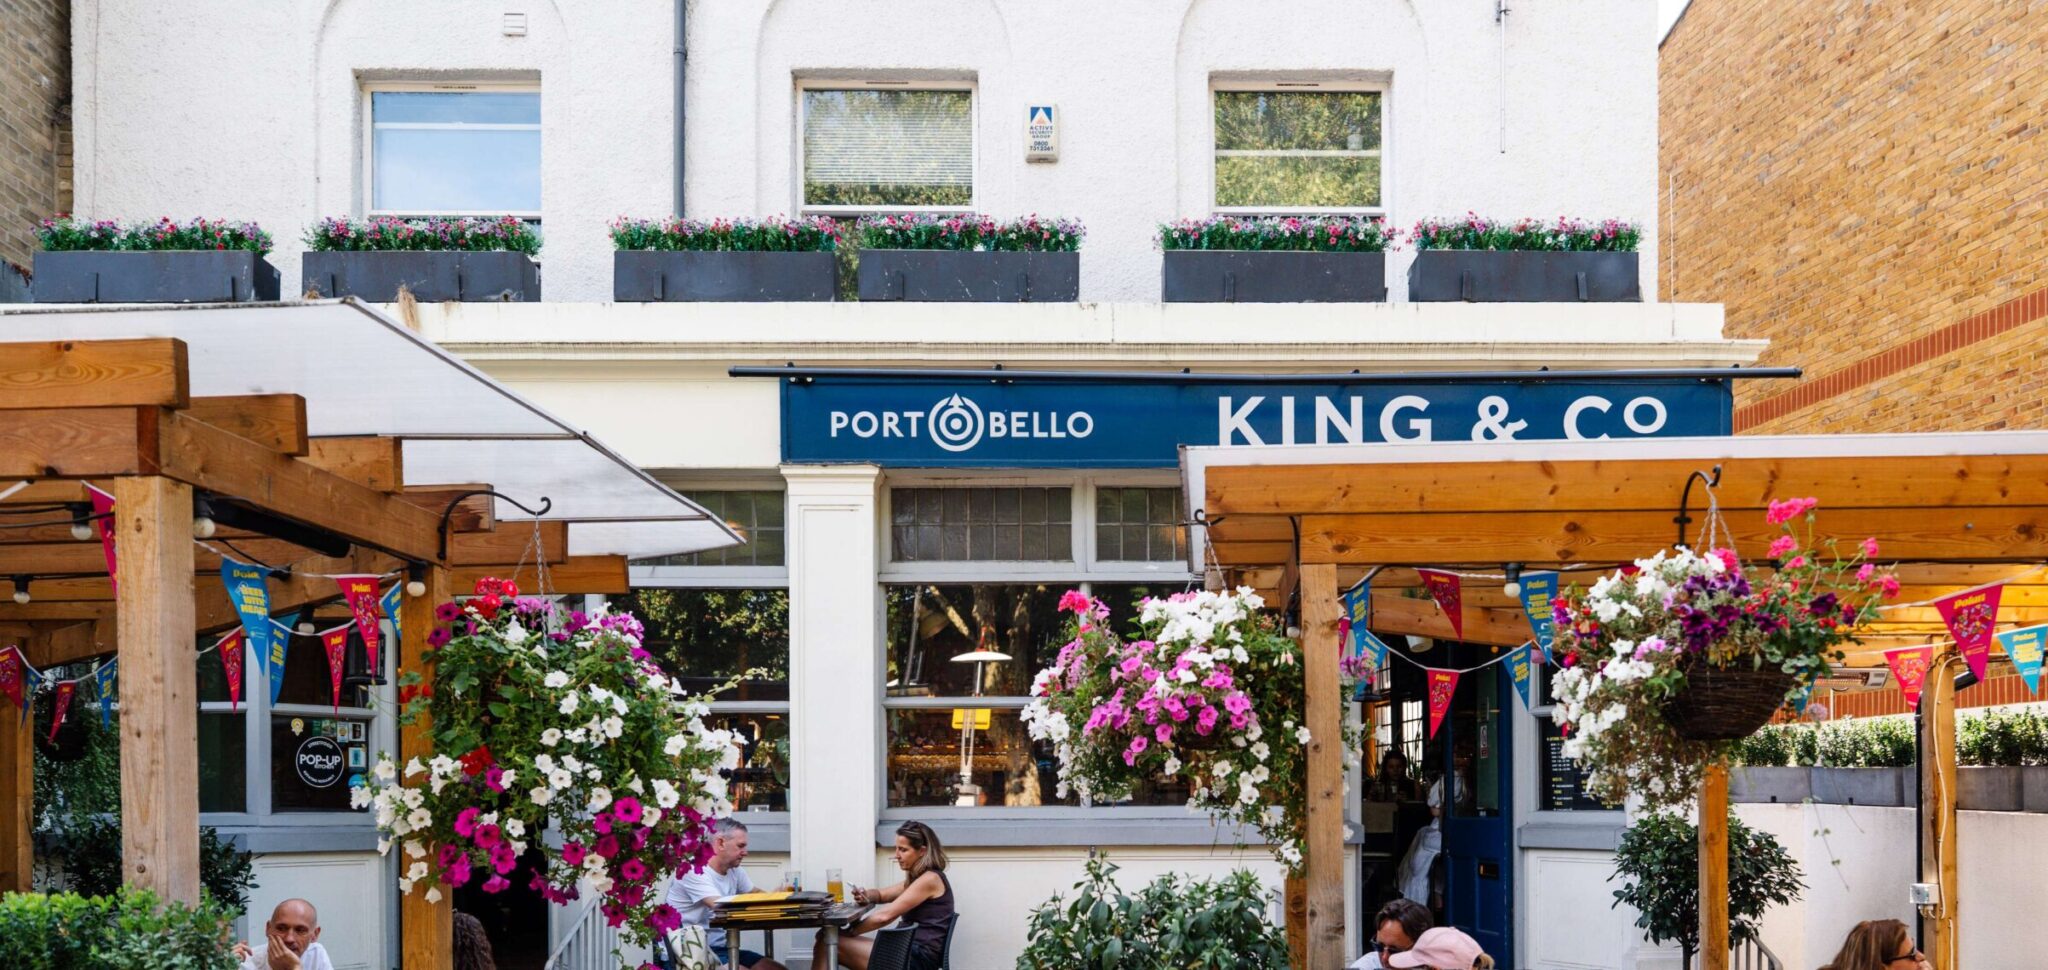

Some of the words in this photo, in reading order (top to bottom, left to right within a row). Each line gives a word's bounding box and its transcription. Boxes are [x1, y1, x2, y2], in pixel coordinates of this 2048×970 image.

[1218, 395, 1432, 447] KING
[1471, 395, 1529, 442] &
[299, 754, 341, 766] POP-UP
